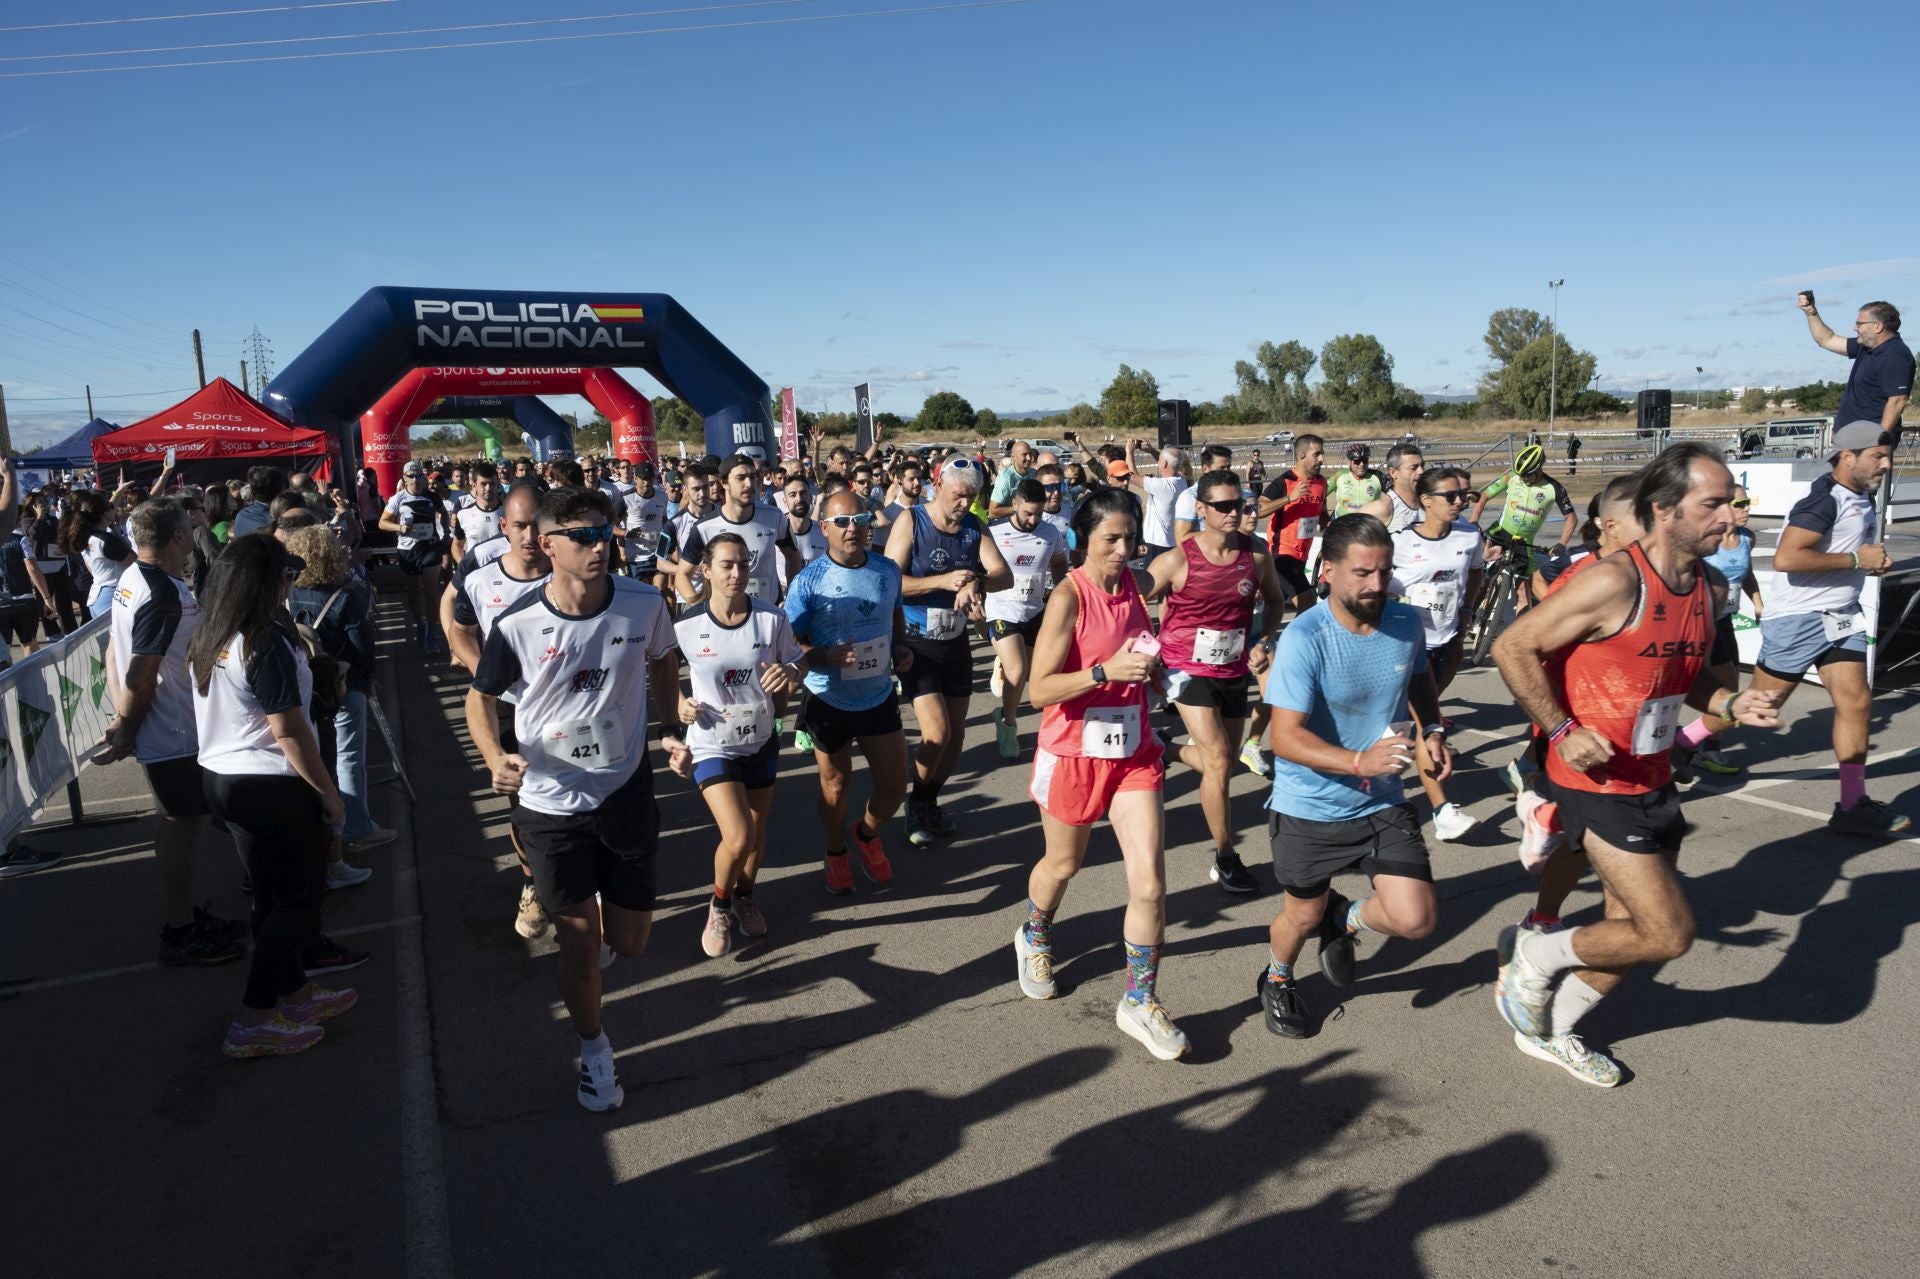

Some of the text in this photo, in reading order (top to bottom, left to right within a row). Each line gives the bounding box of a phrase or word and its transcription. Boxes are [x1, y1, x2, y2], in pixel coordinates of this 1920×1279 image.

[417, 325, 645, 348] NACIONAL
[508, 367, 581, 375] Santander
[192, 411, 243, 423] Sports
[185, 423, 267, 433] Santander
[732, 422, 765, 444] RUTA
[106, 445, 138, 456] Sports
[220, 441, 252, 451] Sports
[1739, 471, 1750, 490] 1
[1020, 588, 1033, 596] 177
[1427, 602, 1445, 612] 298
[1210, 648, 1230, 657] 276
[858, 658, 878, 671] 252
[735, 724, 758, 736] 161
[1103, 733, 1129, 746] 417
[570, 743, 601, 759] 421
